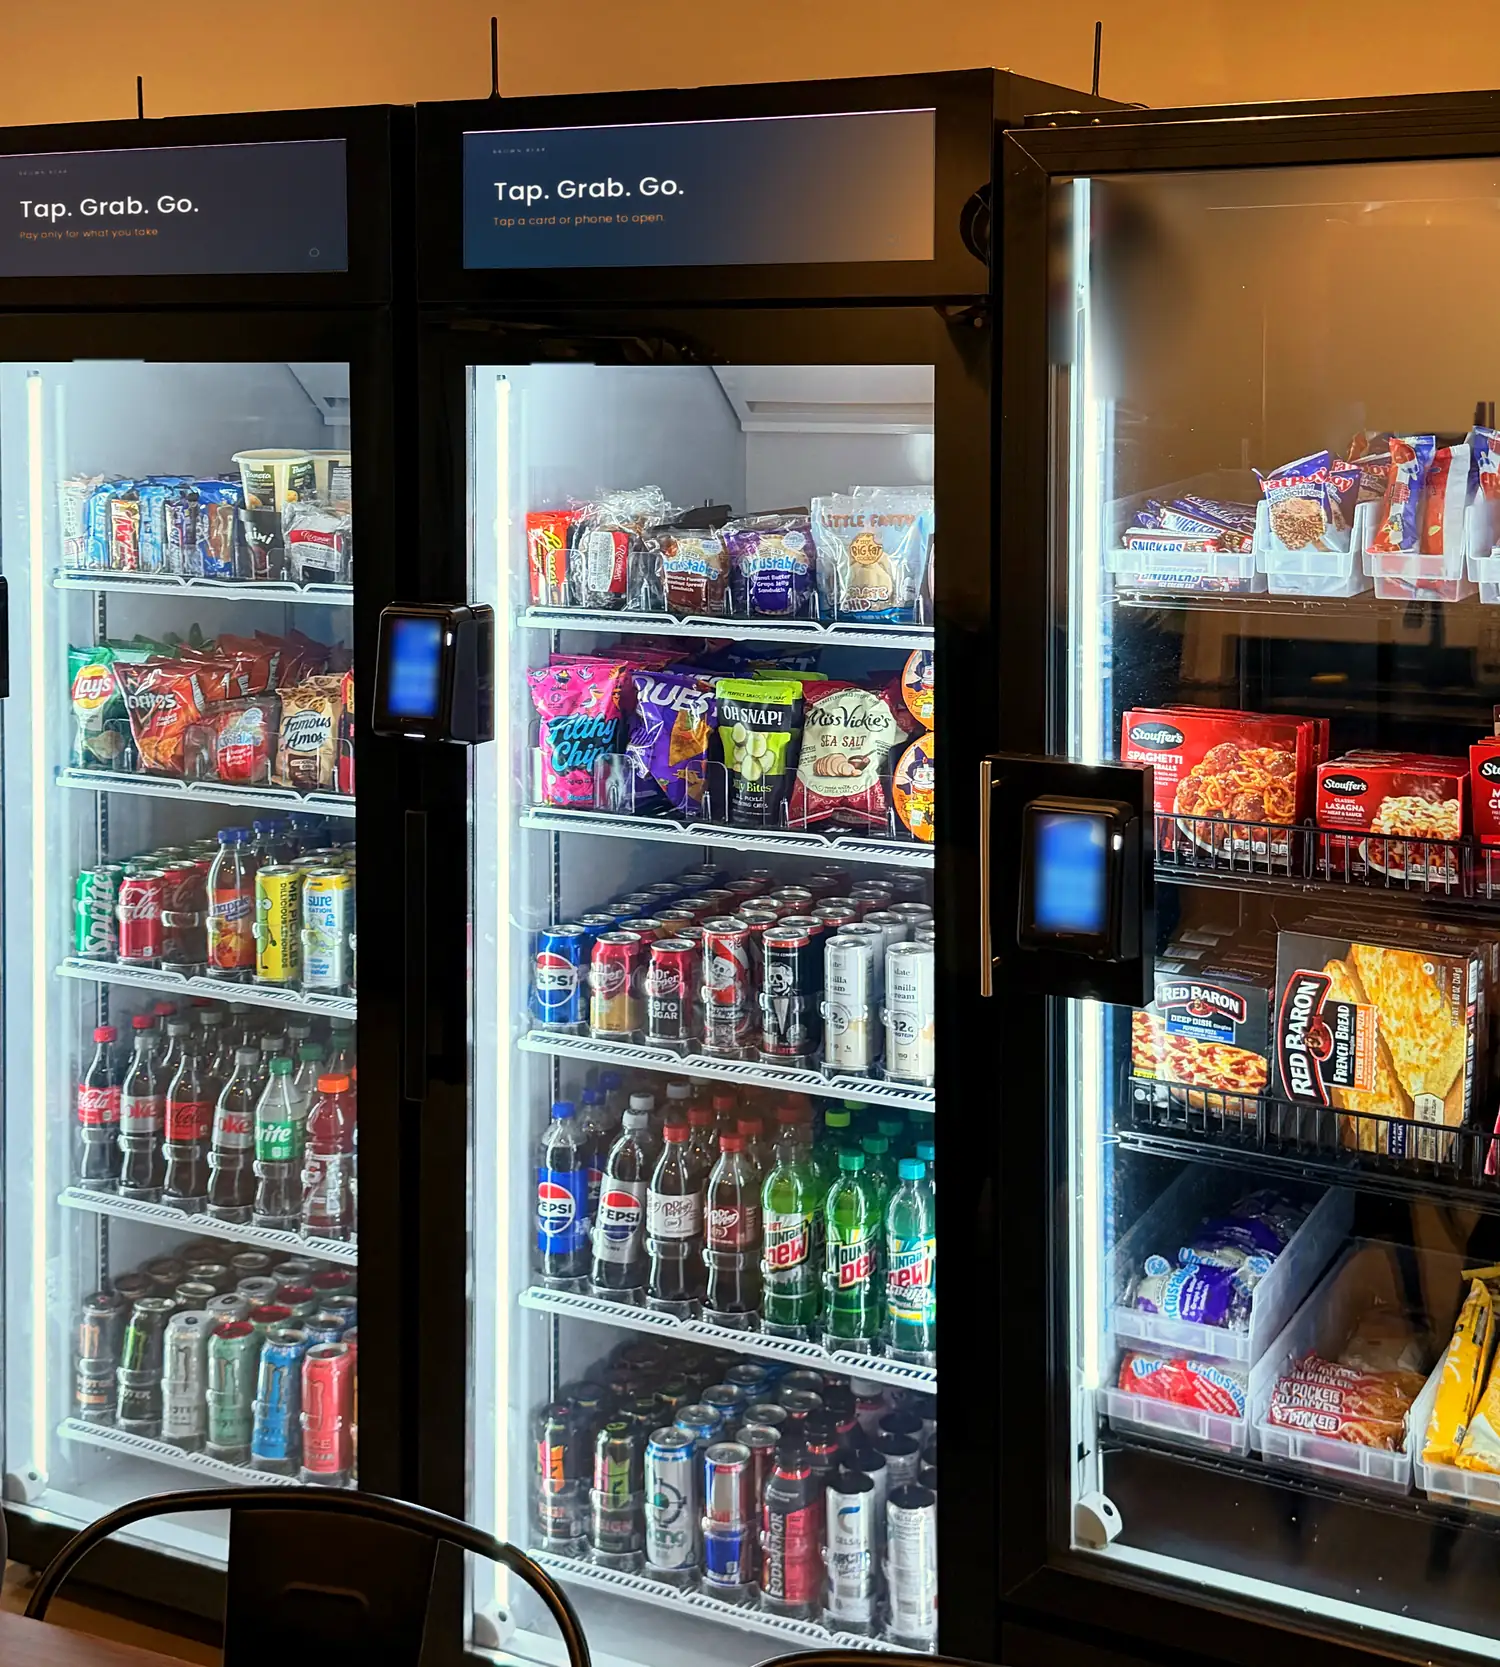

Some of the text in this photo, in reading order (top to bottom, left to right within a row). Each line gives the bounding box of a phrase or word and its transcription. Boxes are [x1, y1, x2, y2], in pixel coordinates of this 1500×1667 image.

[494, 176, 684, 206] Tap. Grab. Go.
[20, 195, 199, 223] Tap. Grab. Go.
[494, 217, 514, 228] Tap
[518, 218, 526, 226] a
[529, 215, 556, 226] card
[559, 216, 571, 225] or
[575, 213, 612, 226] phone
[616, 213, 628, 223] to
[19, 227, 158, 242] Pay only for what you take
[1269, 490, 1307, 503] ANDWICH
[1162, 513, 1222, 535] NICKERS
[1131, 540, 1183, 552] SNICKERS
[543, 530, 564, 588] Reese's
[740, 556, 808, 577] Uustables
[663, 558, 719, 580] ncrustables
[723, 705, 783, 725] OH SNAP!
[806, 704, 892, 732] Miss Vickie's
[281, 715, 332, 738] Famous
[546, 713, 617, 743] Filthy
[1130, 727, 1183, 744] Stouffer's
[286, 731, 324, 750] Amos
[821, 735, 867, 747] SEA SALT
[1127, 750, 1183, 765] SPAGHETTI
[746, 782, 772, 793] Bites
[1324, 778, 1367, 791] Stouffer's
[1325, 802, 1365, 812] LASAGNA
[288, 881, 298, 907] MR.
[308, 895, 332, 907] sure
[86, 872, 116, 952] Sprite
[539, 971, 574, 986] EPSI
[654, 969, 671, 979] Dr
[894, 984, 917, 992] anilla
[1161, 985, 1240, 1014] RED BARON
[1170, 1014, 1192, 1024] DEEP
[1192, 1017, 1213, 1028] DISH
[1285, 980, 1321, 1097] RED BARON
[1333, 1004, 1350, 1084] FRENCH BREAD
[129, 1103, 157, 1119] oke
[221, 1115, 250, 1134] oke
[256, 1125, 291, 1143] rite
[538, 1200, 572, 1215] EPSI
[663, 1202, 693, 1218] Pepper
[767, 1221, 782, 1230] IET
[1164, 1262, 1200, 1321] nCrustables
[1293, 1383, 1341, 1404] POCKETS
[1288, 1410, 1337, 1431] POCKETS
[836, 1535, 869, 1546] CELSIS
[769, 1512, 785, 1597] BODYARMOR
